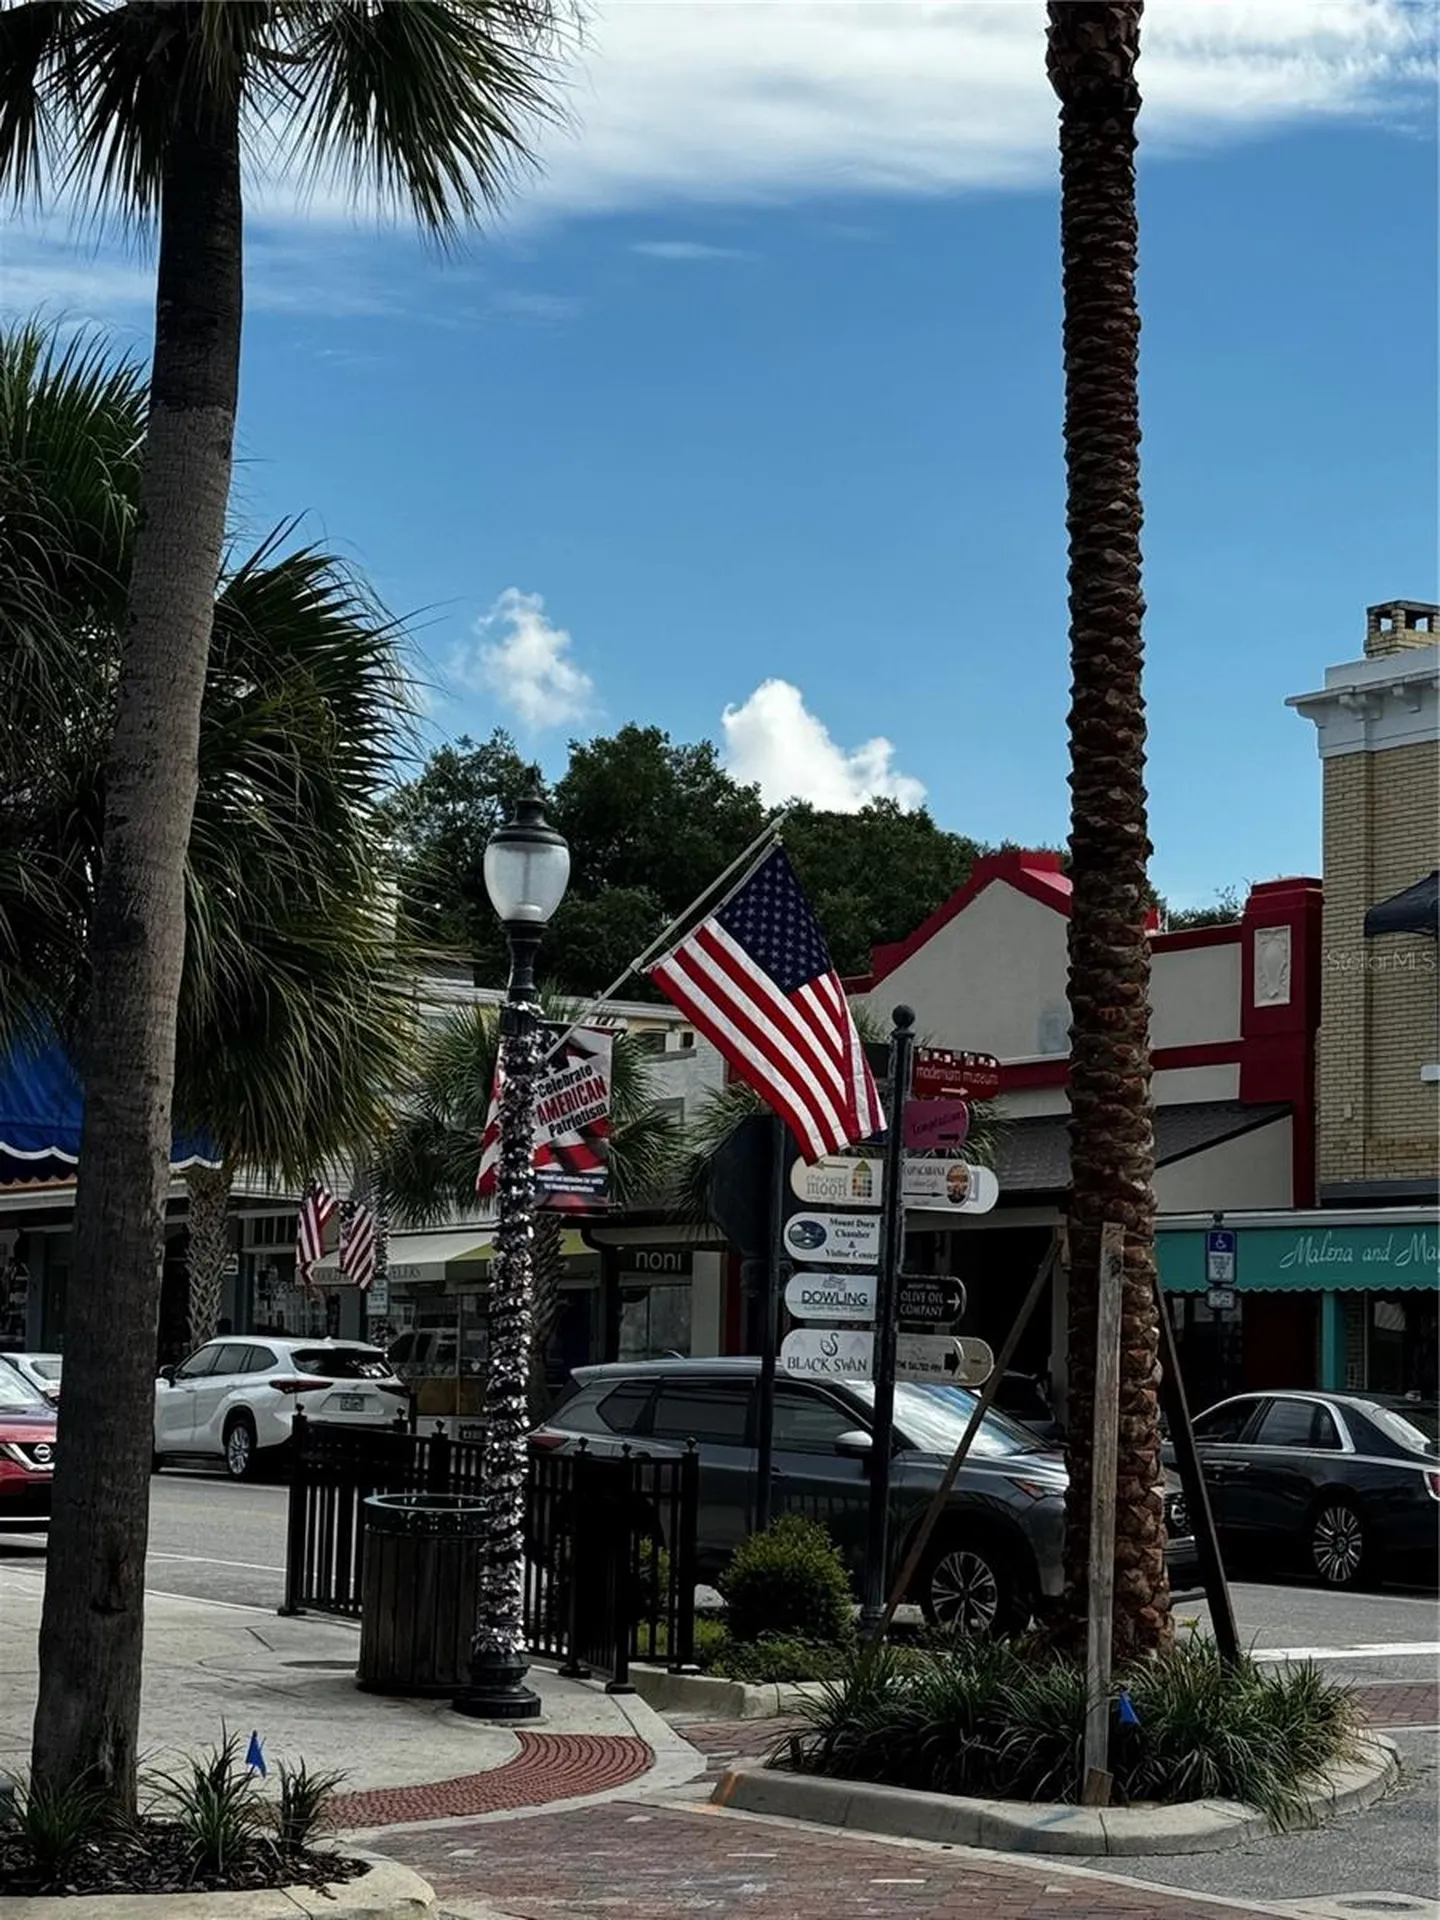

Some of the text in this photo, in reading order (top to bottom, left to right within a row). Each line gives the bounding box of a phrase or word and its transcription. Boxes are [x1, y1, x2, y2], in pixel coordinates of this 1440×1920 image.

[537, 1064, 593, 1098] Celebrate
[963, 1070, 999, 1086] museum
[536, 1075, 608, 1126] AMERICAN
[548, 1102, 608, 1138] Patriotism
[806, 1183, 848, 1197] moon
[829, 1217, 875, 1228] Mount Dora
[835, 1229, 870, 1239] Chamber
[848, 1240, 856, 1249] &
[1362, 1232, 1393, 1262] and
[1395, 1231, 1439, 1267] Ma
[635, 1251, 682, 1270] noni
[825, 1248, 878, 1260] Visitor Center
[801, 1289, 868, 1306] DOWLING
[927, 1291, 944, 1304] OIL
[899, 1303, 944, 1317] COMPANY
[787, 1356, 867, 1373] BLACK SWAN
